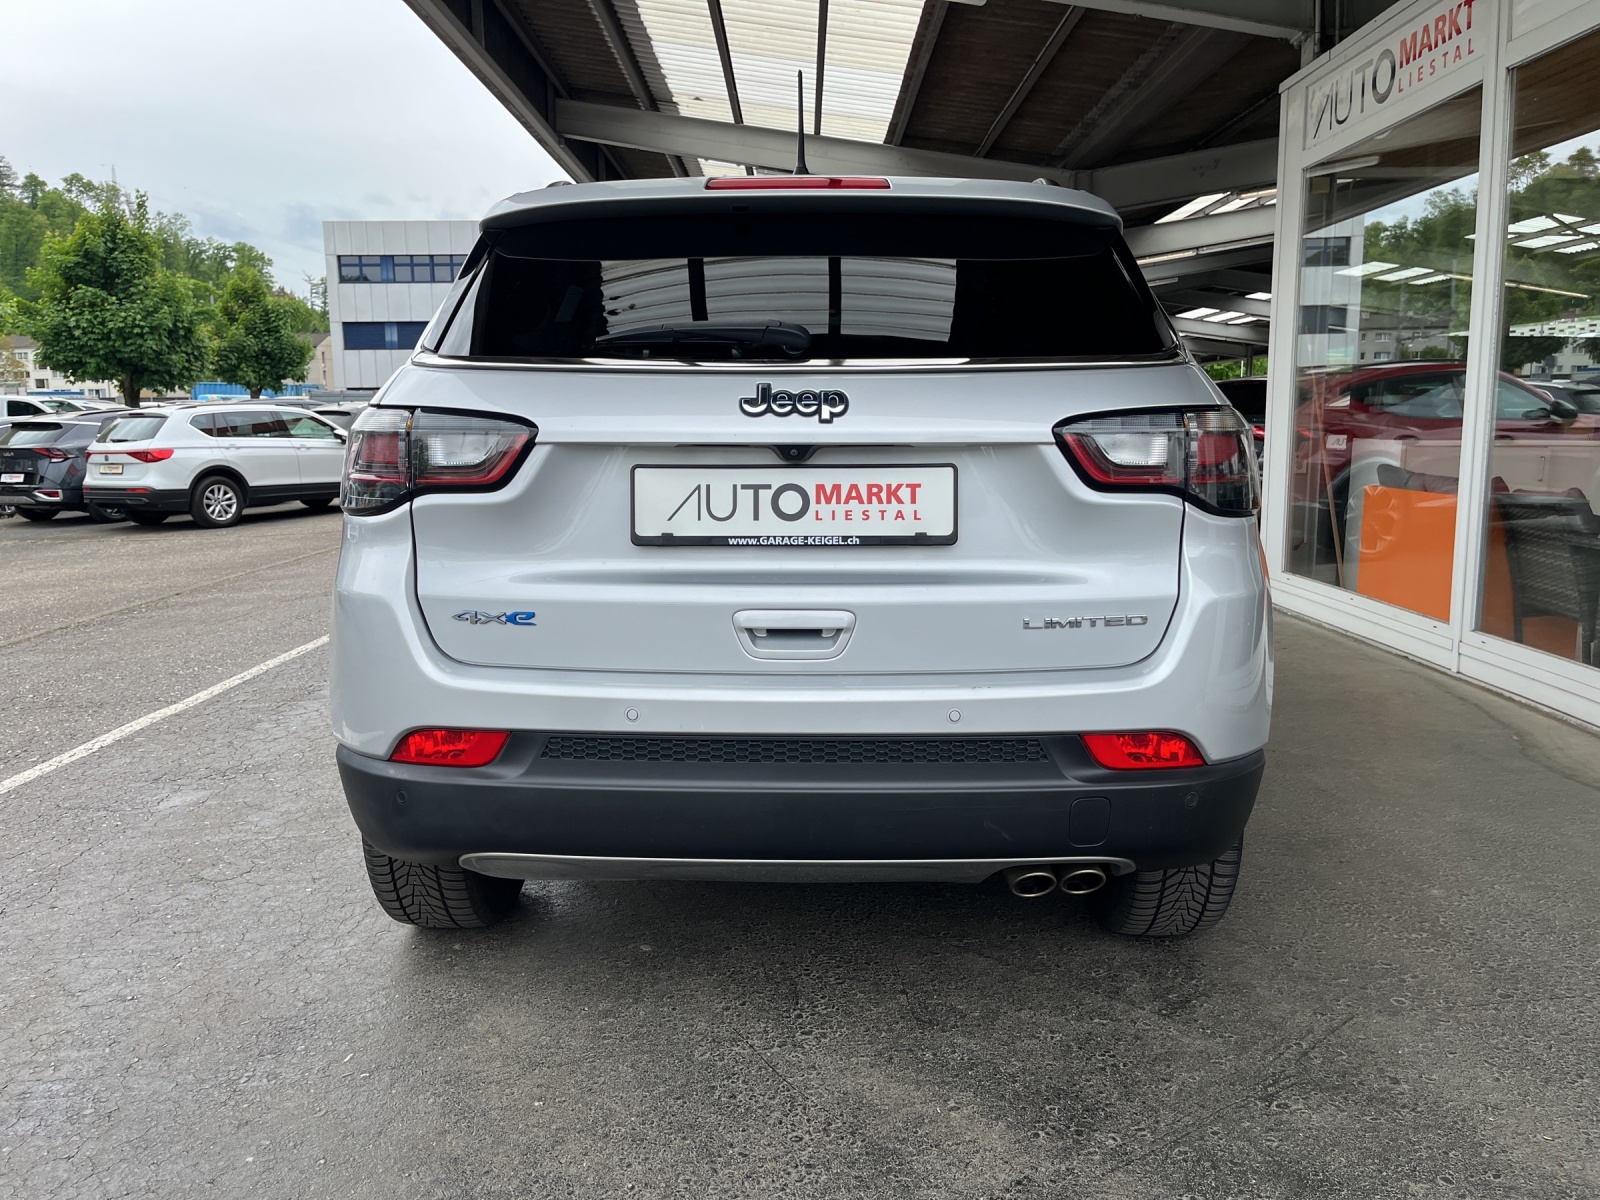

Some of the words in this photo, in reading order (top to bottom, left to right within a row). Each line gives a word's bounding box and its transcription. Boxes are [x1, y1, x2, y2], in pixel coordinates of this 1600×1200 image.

[1313, 48, 1396, 139] AUTO
[1399, 0, 1477, 69] MARKT
[1397, 38, 1475, 93] LIESTAL
[739, 382, 849, 423] Jeep
[667, 483, 810, 522] AUTO
[815, 483, 922, 505] MARKT
[815, 509, 922, 521] LIESTAL
[728, 535, 860, 546] www.GARAGE-KEIGEL.ch
[1022, 614, 1148, 630] LIMITED
